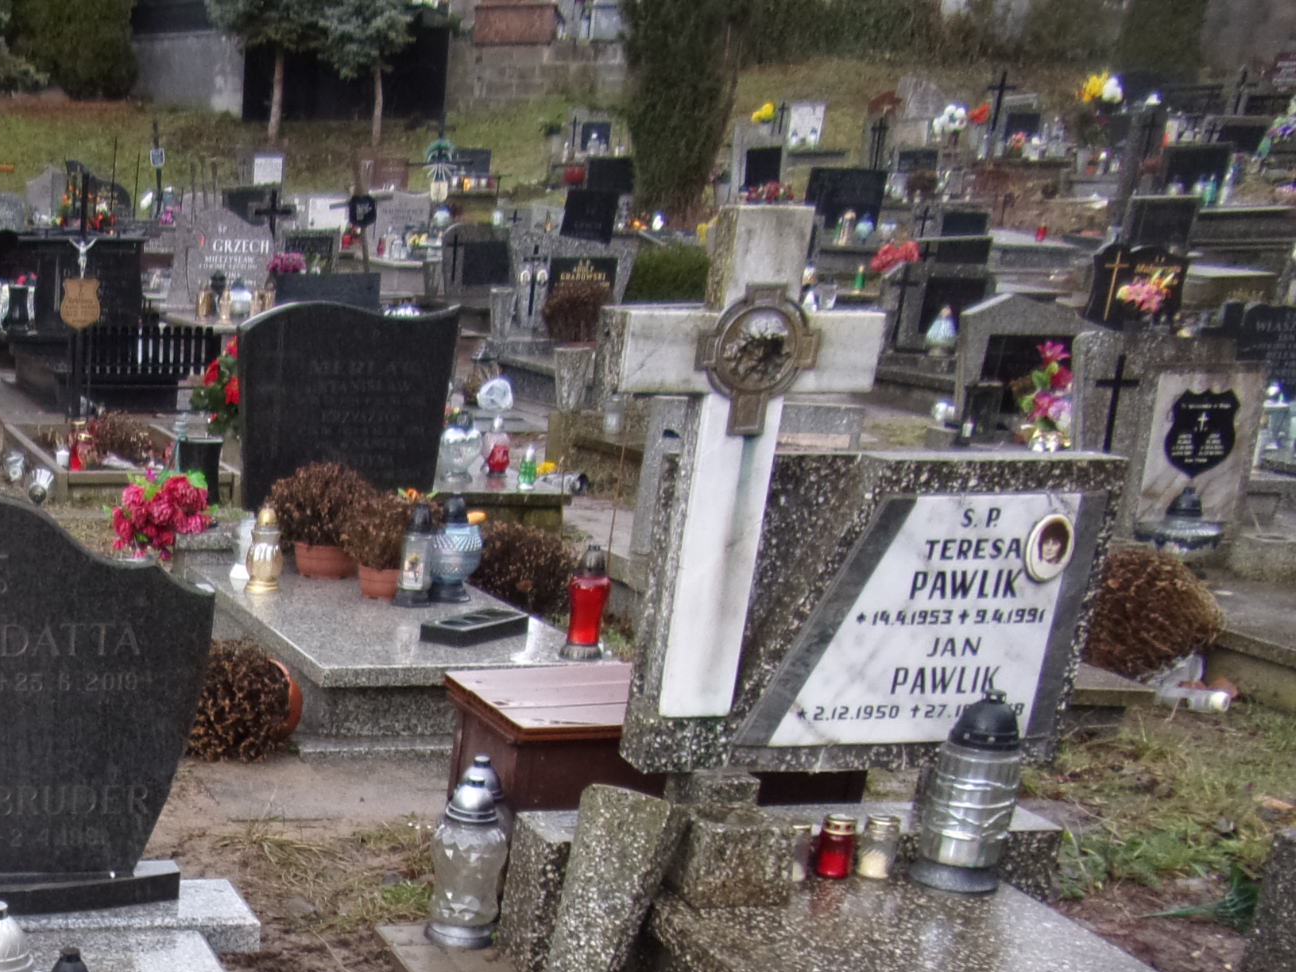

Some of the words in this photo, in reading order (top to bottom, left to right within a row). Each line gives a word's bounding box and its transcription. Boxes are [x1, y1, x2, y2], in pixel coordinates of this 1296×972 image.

[212, 238, 271, 255] GRZECH
[924, 538, 1023, 561] TERESA
[909, 568, 1024, 601] PAWLIK
[871, 607, 952, 626] 14.4.1953
[0, 622, 142, 660] DATTA
[926, 636, 982, 658] JAN
[890, 665, 1000, 696] PAWLIK
[813, 704, 900, 723] 2.12.1950
